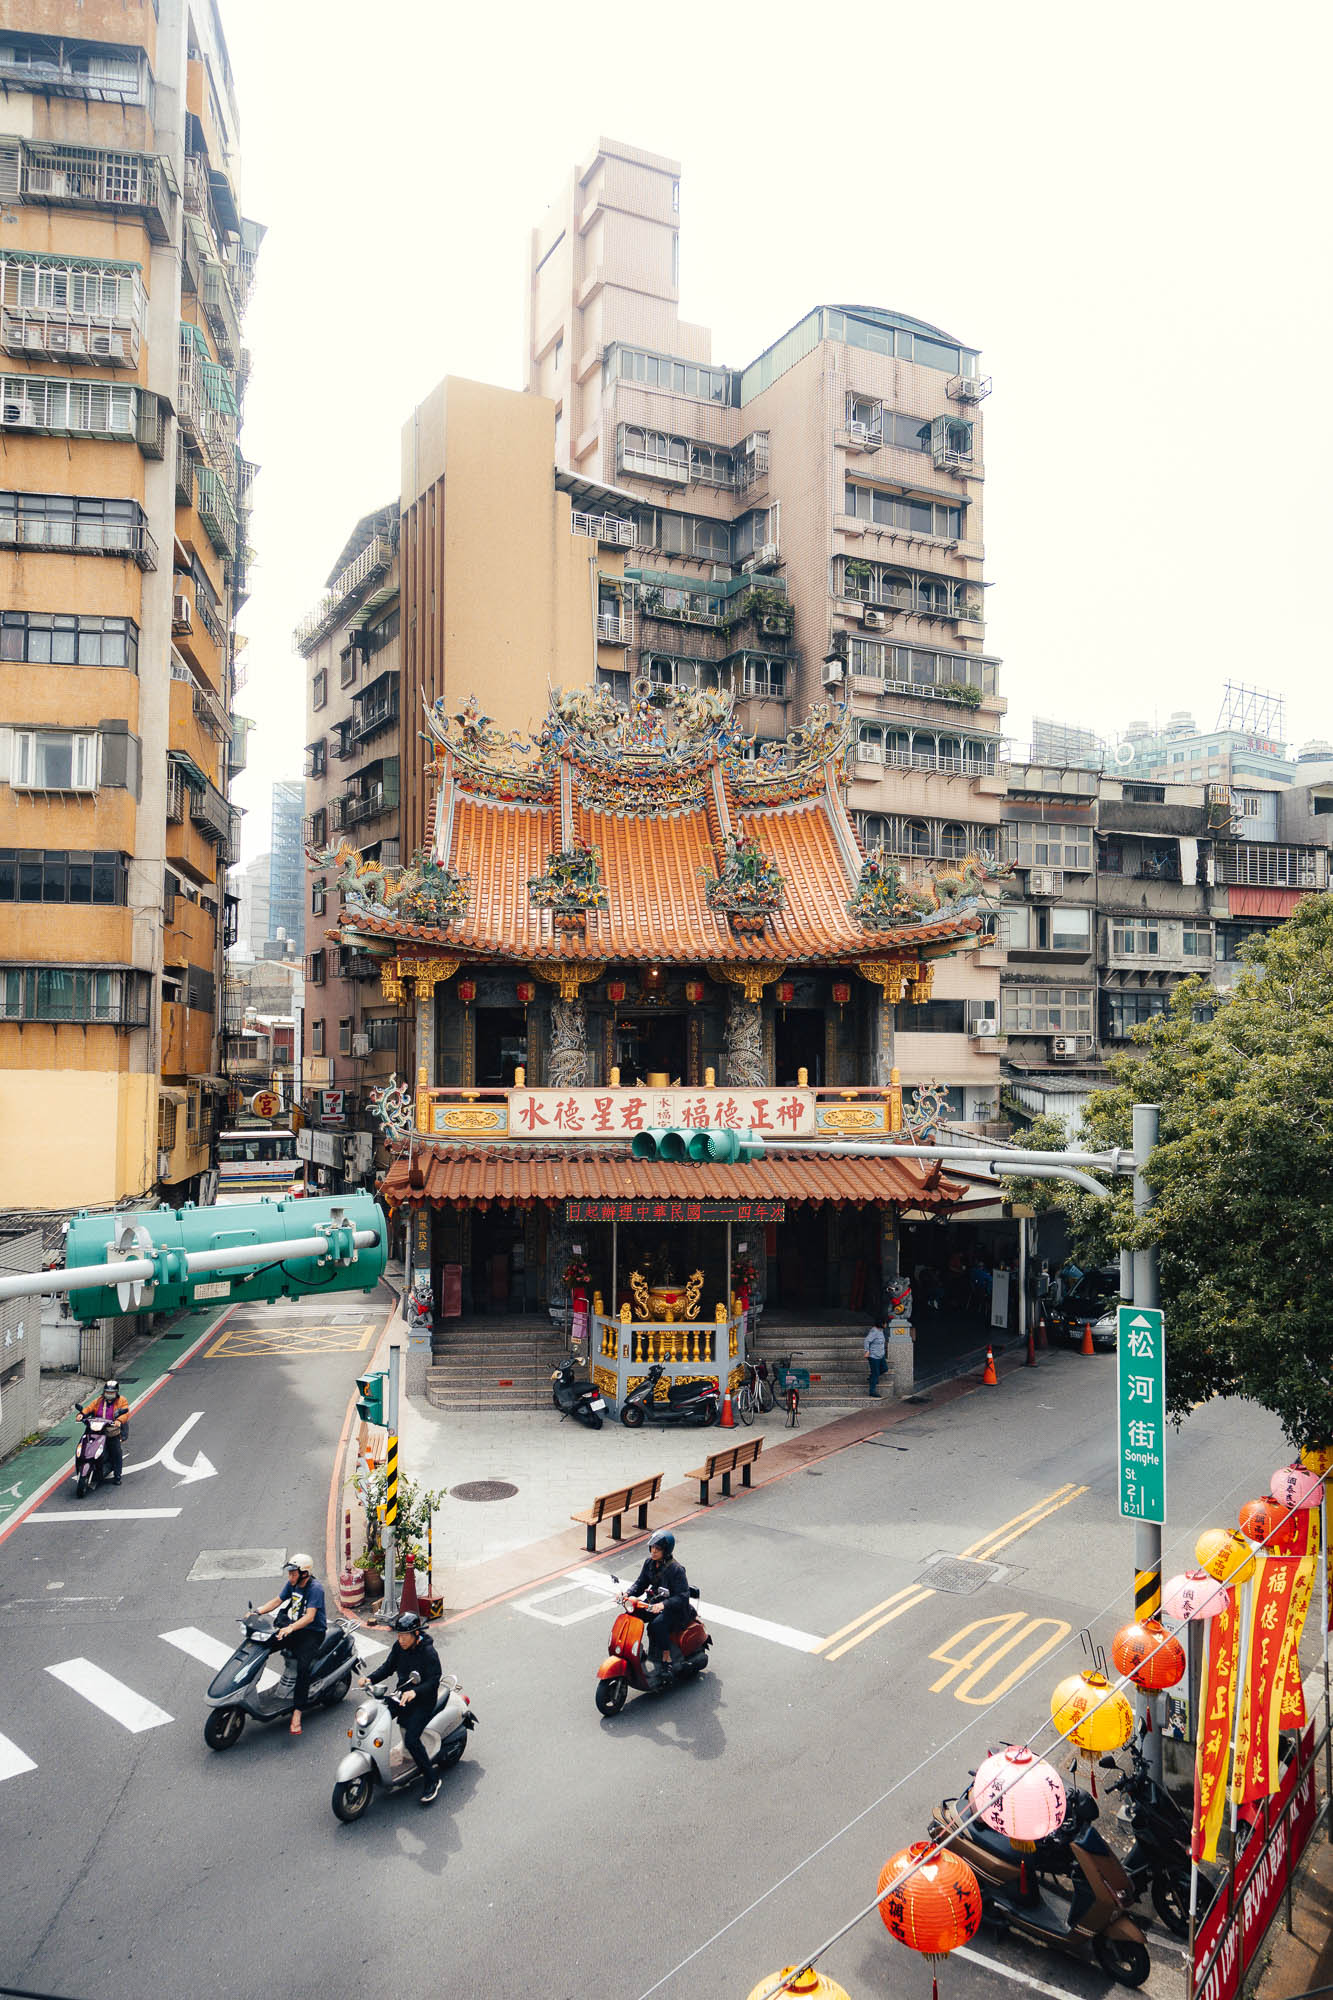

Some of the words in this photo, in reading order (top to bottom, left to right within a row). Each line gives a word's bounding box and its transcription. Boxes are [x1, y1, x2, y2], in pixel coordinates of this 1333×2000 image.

[259, 1094, 277, 1116] 宮
[519, 1096, 648, 1131] 水德星君
[682, 1096, 805, 1131] 福德正神
[1127, 1329, 1156, 1449] 松河街
[1125, 1448, 1160, 1467] SongHe
[1125, 1467, 1137, 1480] St.
[927, 1611, 1073, 1705] 40
